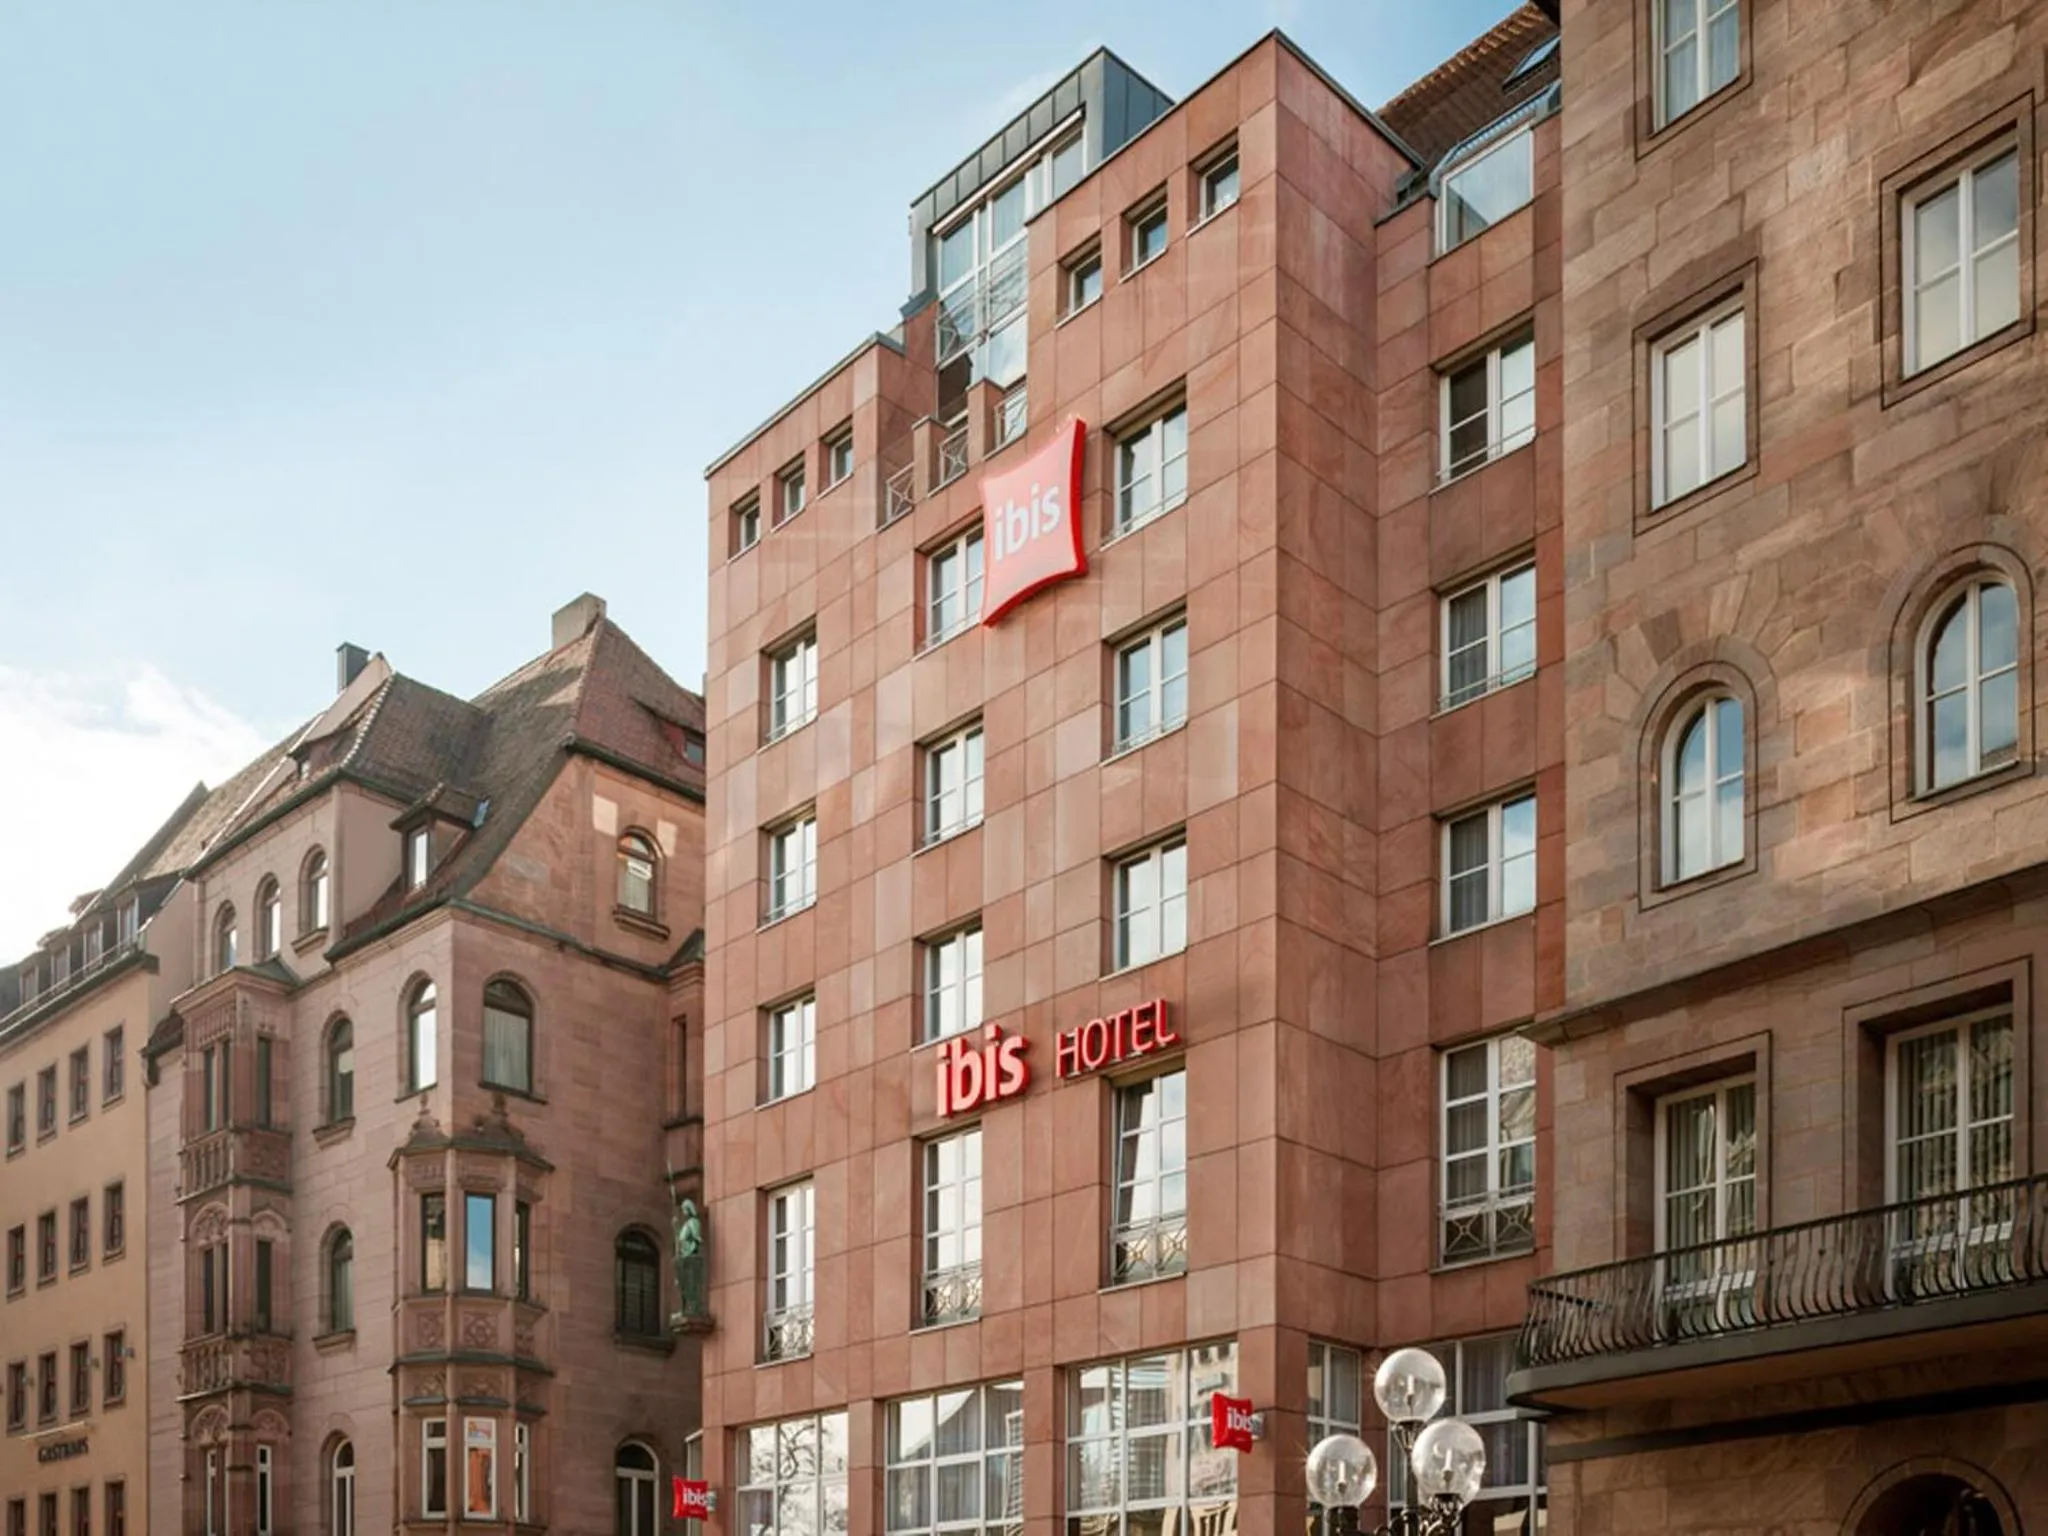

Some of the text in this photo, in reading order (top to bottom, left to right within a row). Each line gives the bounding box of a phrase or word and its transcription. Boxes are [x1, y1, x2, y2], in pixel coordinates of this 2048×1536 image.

[993, 481, 1061, 562] ibis
[936, 997, 1179, 1119] ibis HOTEL
[1226, 1406, 1253, 1433] ibis
[683, 1487, 708, 1507] ibis
